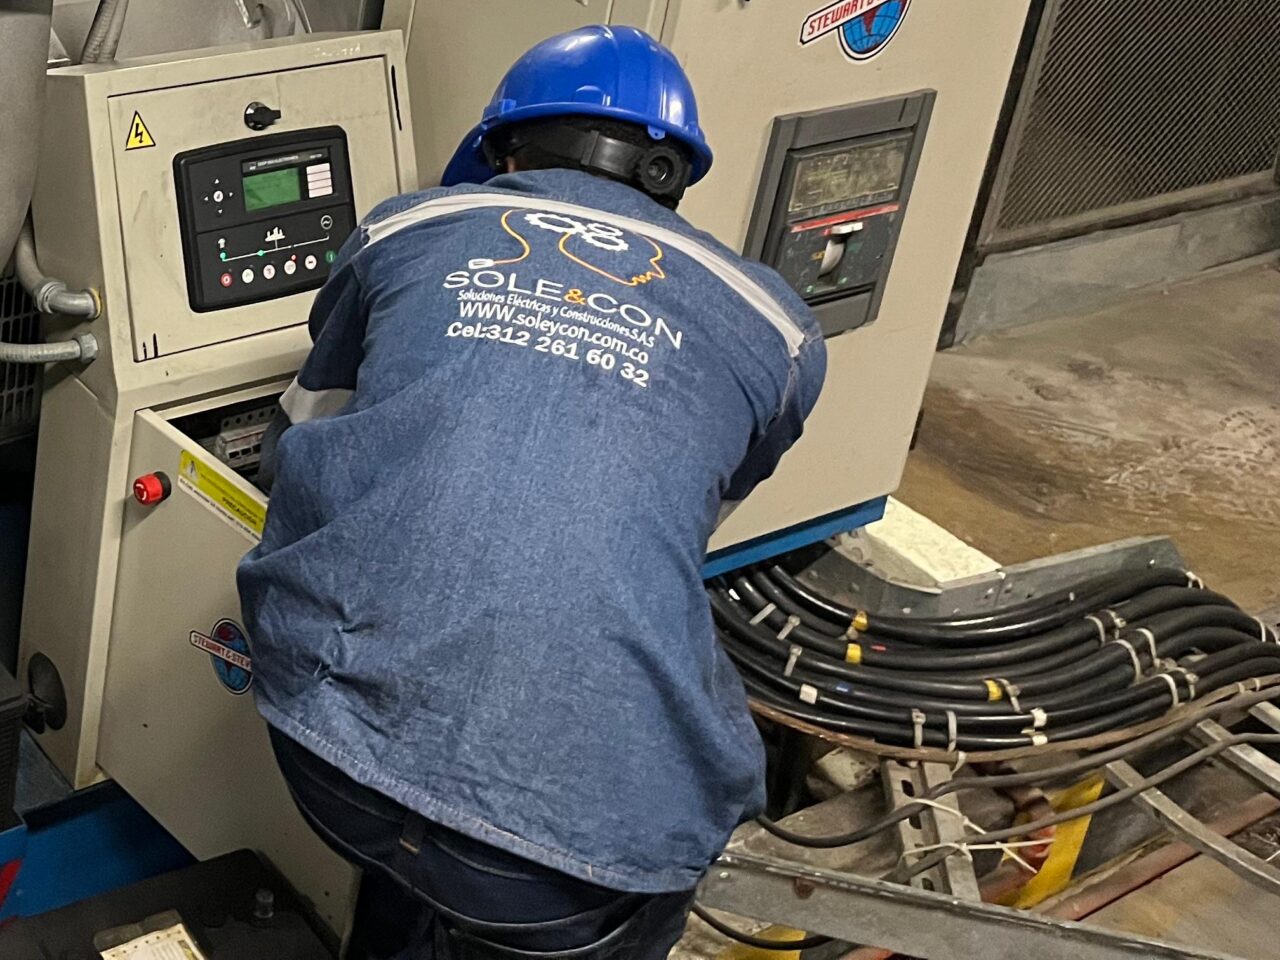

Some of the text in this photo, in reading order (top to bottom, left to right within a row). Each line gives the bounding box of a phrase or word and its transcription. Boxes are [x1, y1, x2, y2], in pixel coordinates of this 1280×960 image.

[457, 288, 506, 303] Soluciones
[506, 293, 551, 313] Eléctricas
[550, 305, 560, 318] y
[534, 336, 580, 360] 261
[585, 348, 616, 371] 60
[619, 361, 650, 388] 32
